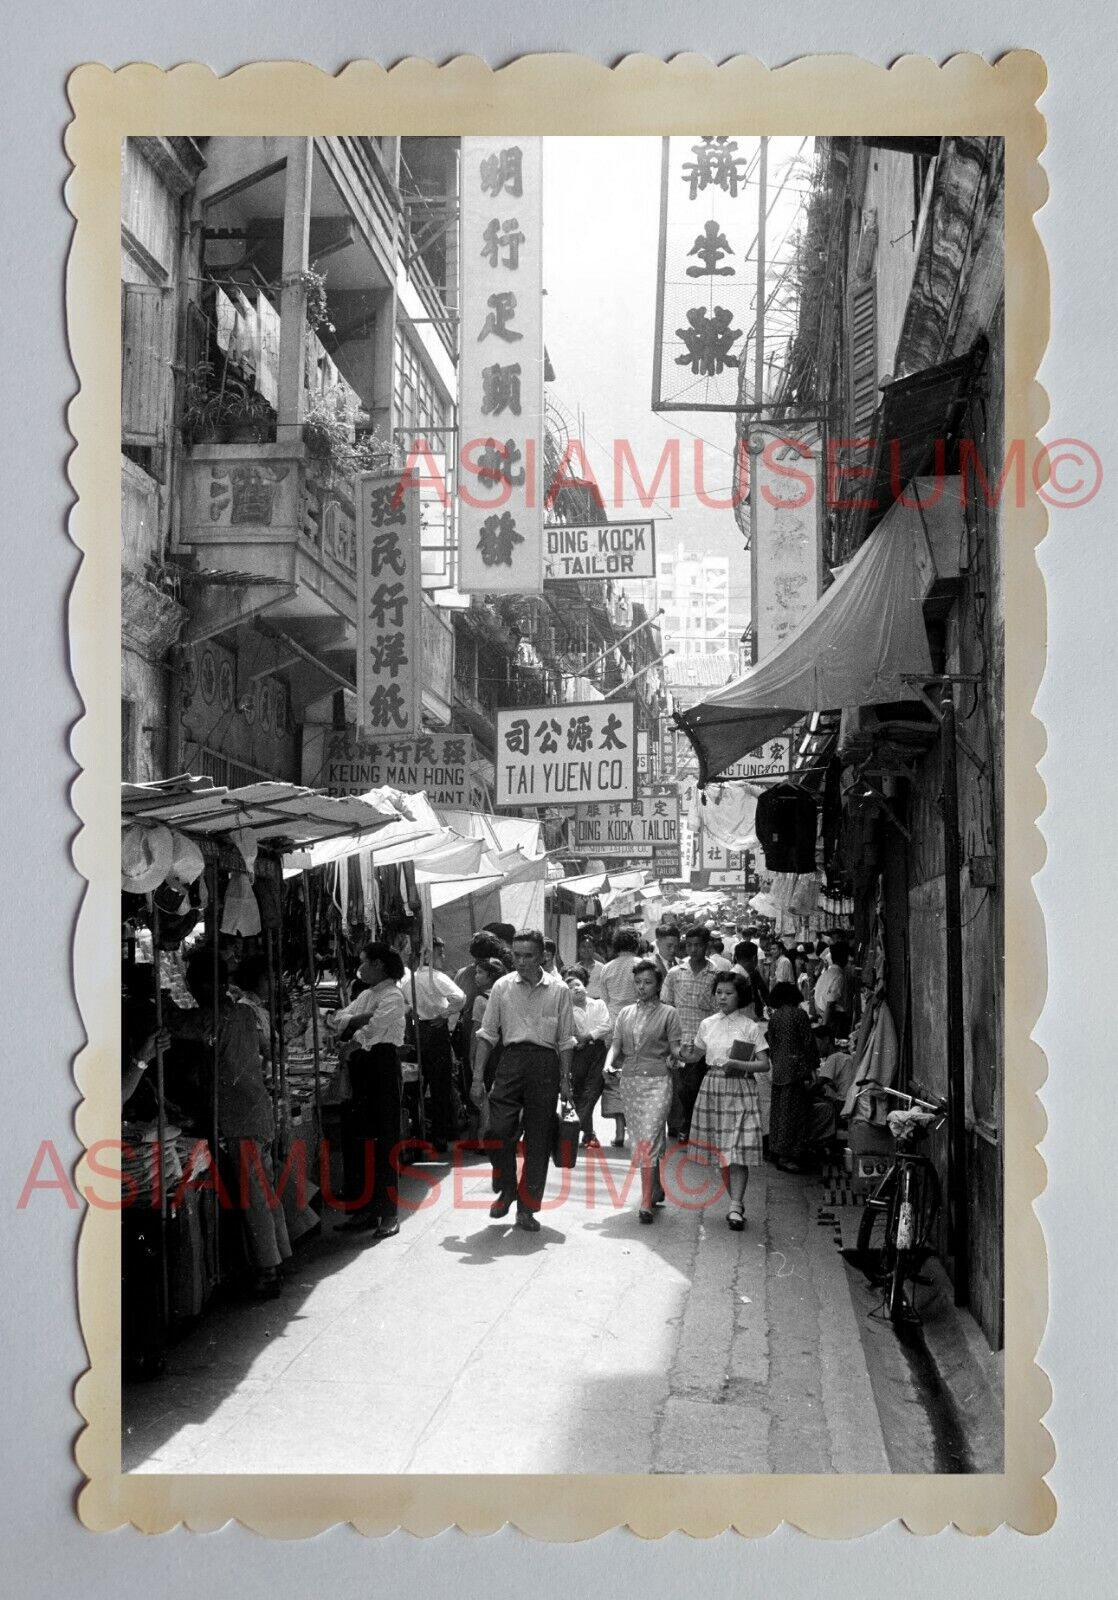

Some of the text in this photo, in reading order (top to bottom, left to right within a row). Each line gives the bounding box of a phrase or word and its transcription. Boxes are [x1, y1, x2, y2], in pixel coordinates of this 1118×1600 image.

[547, 528, 646, 555] DING KOCK
[561, 554, 635, 575] TAILOR
[329, 765, 465, 786] KEUNG MAN HONG
[506, 759, 629, 795] TAI YUEN CO.
[607, 820, 634, 841] KOCK
[641, 819, 677, 841] TAILOR
